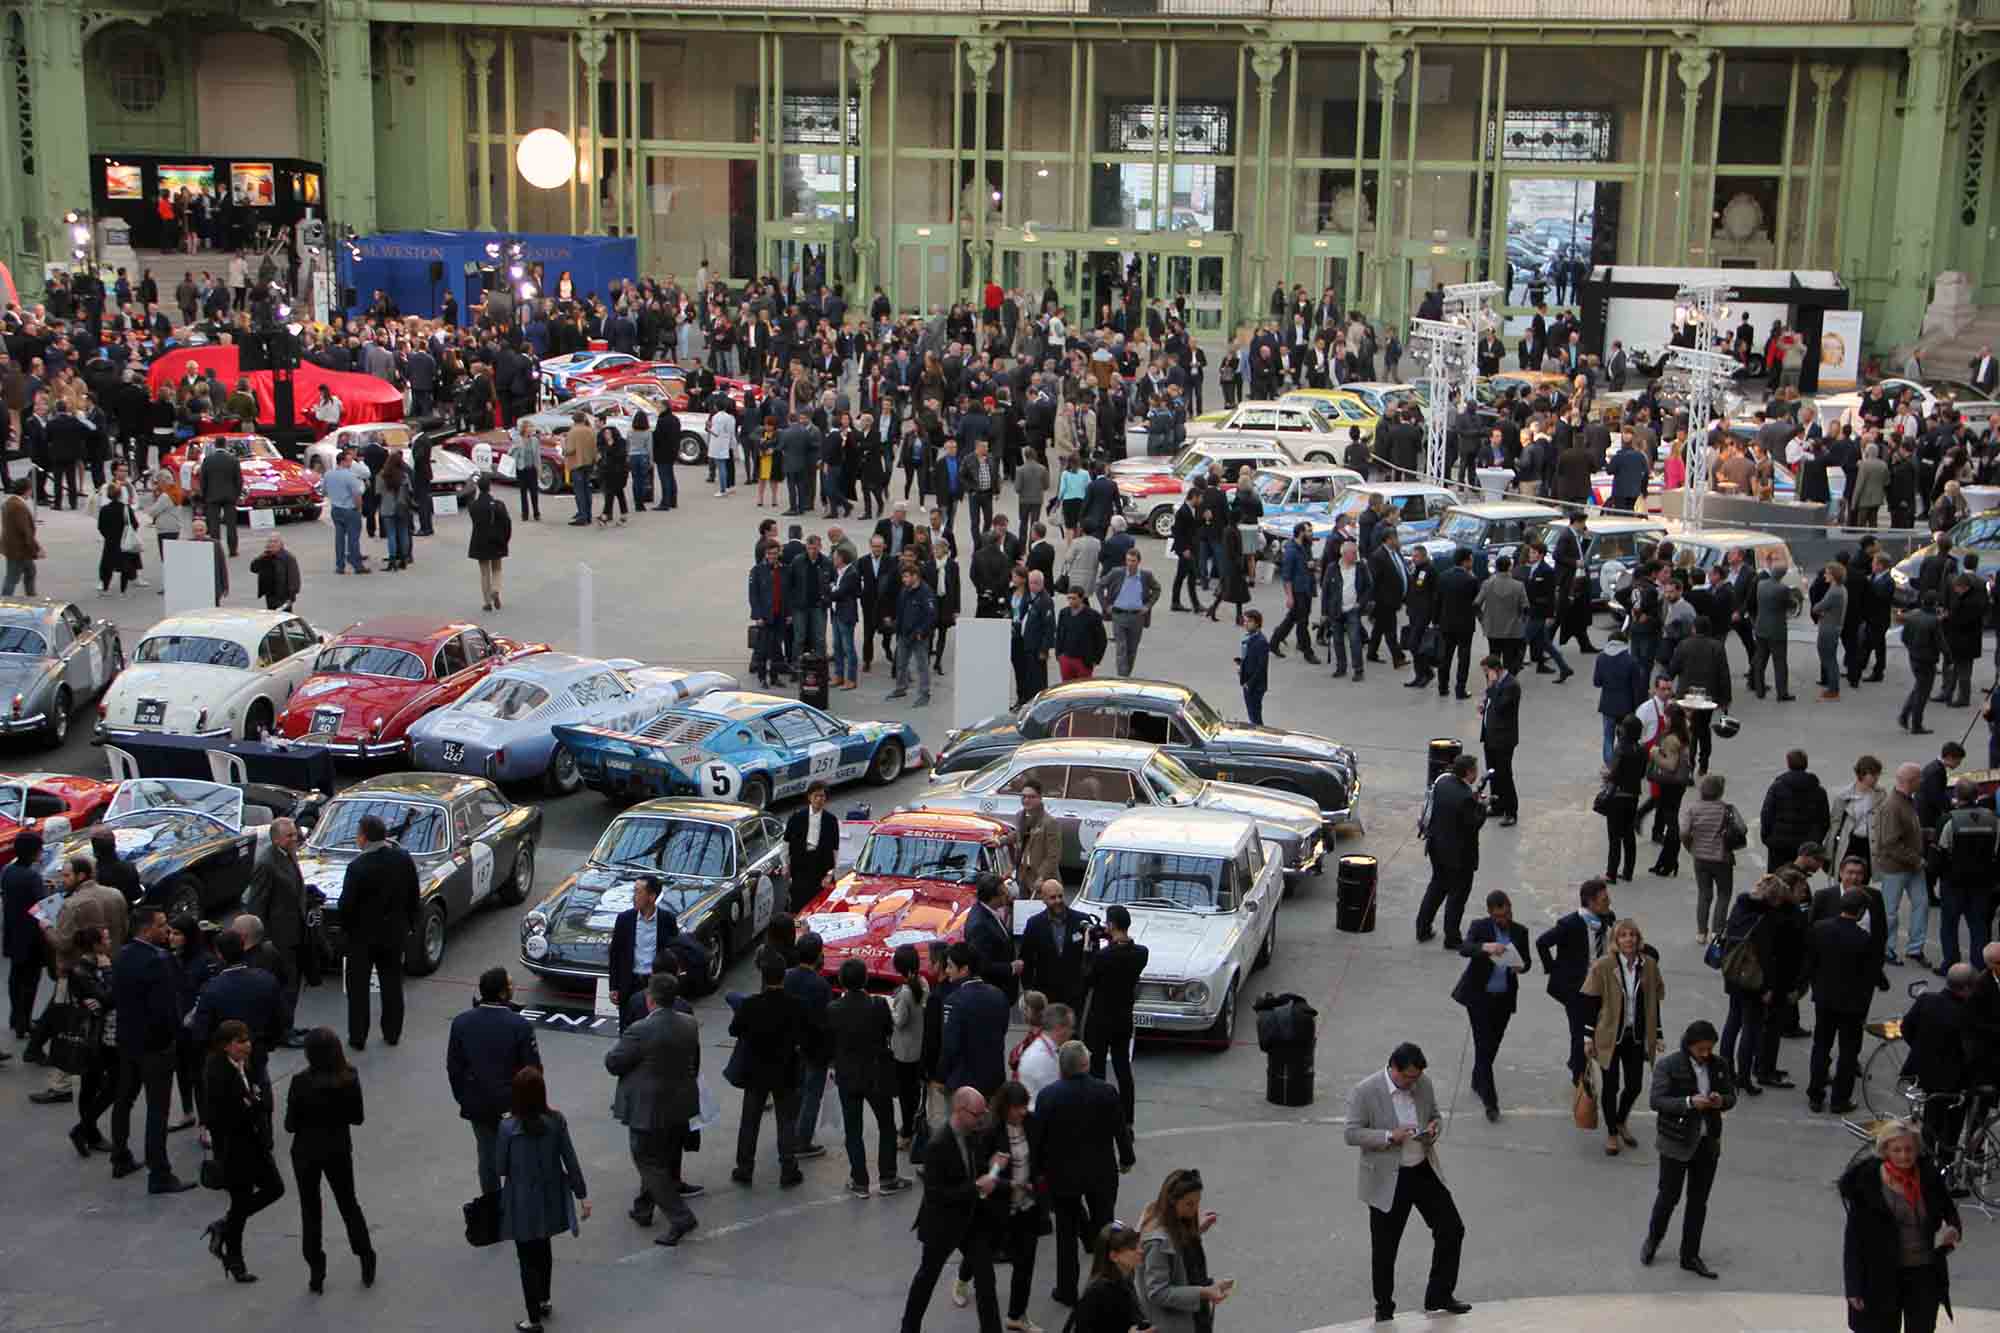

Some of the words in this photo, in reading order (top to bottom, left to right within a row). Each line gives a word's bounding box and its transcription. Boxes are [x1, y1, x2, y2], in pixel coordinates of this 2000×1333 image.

[680, 753, 702, 766] TOTAL
[709, 766, 731, 796] 5
[903, 830, 956, 840] ZENITH
[575, 936, 612, 945] ZENI
[838, 947, 896, 959] ZENITH
